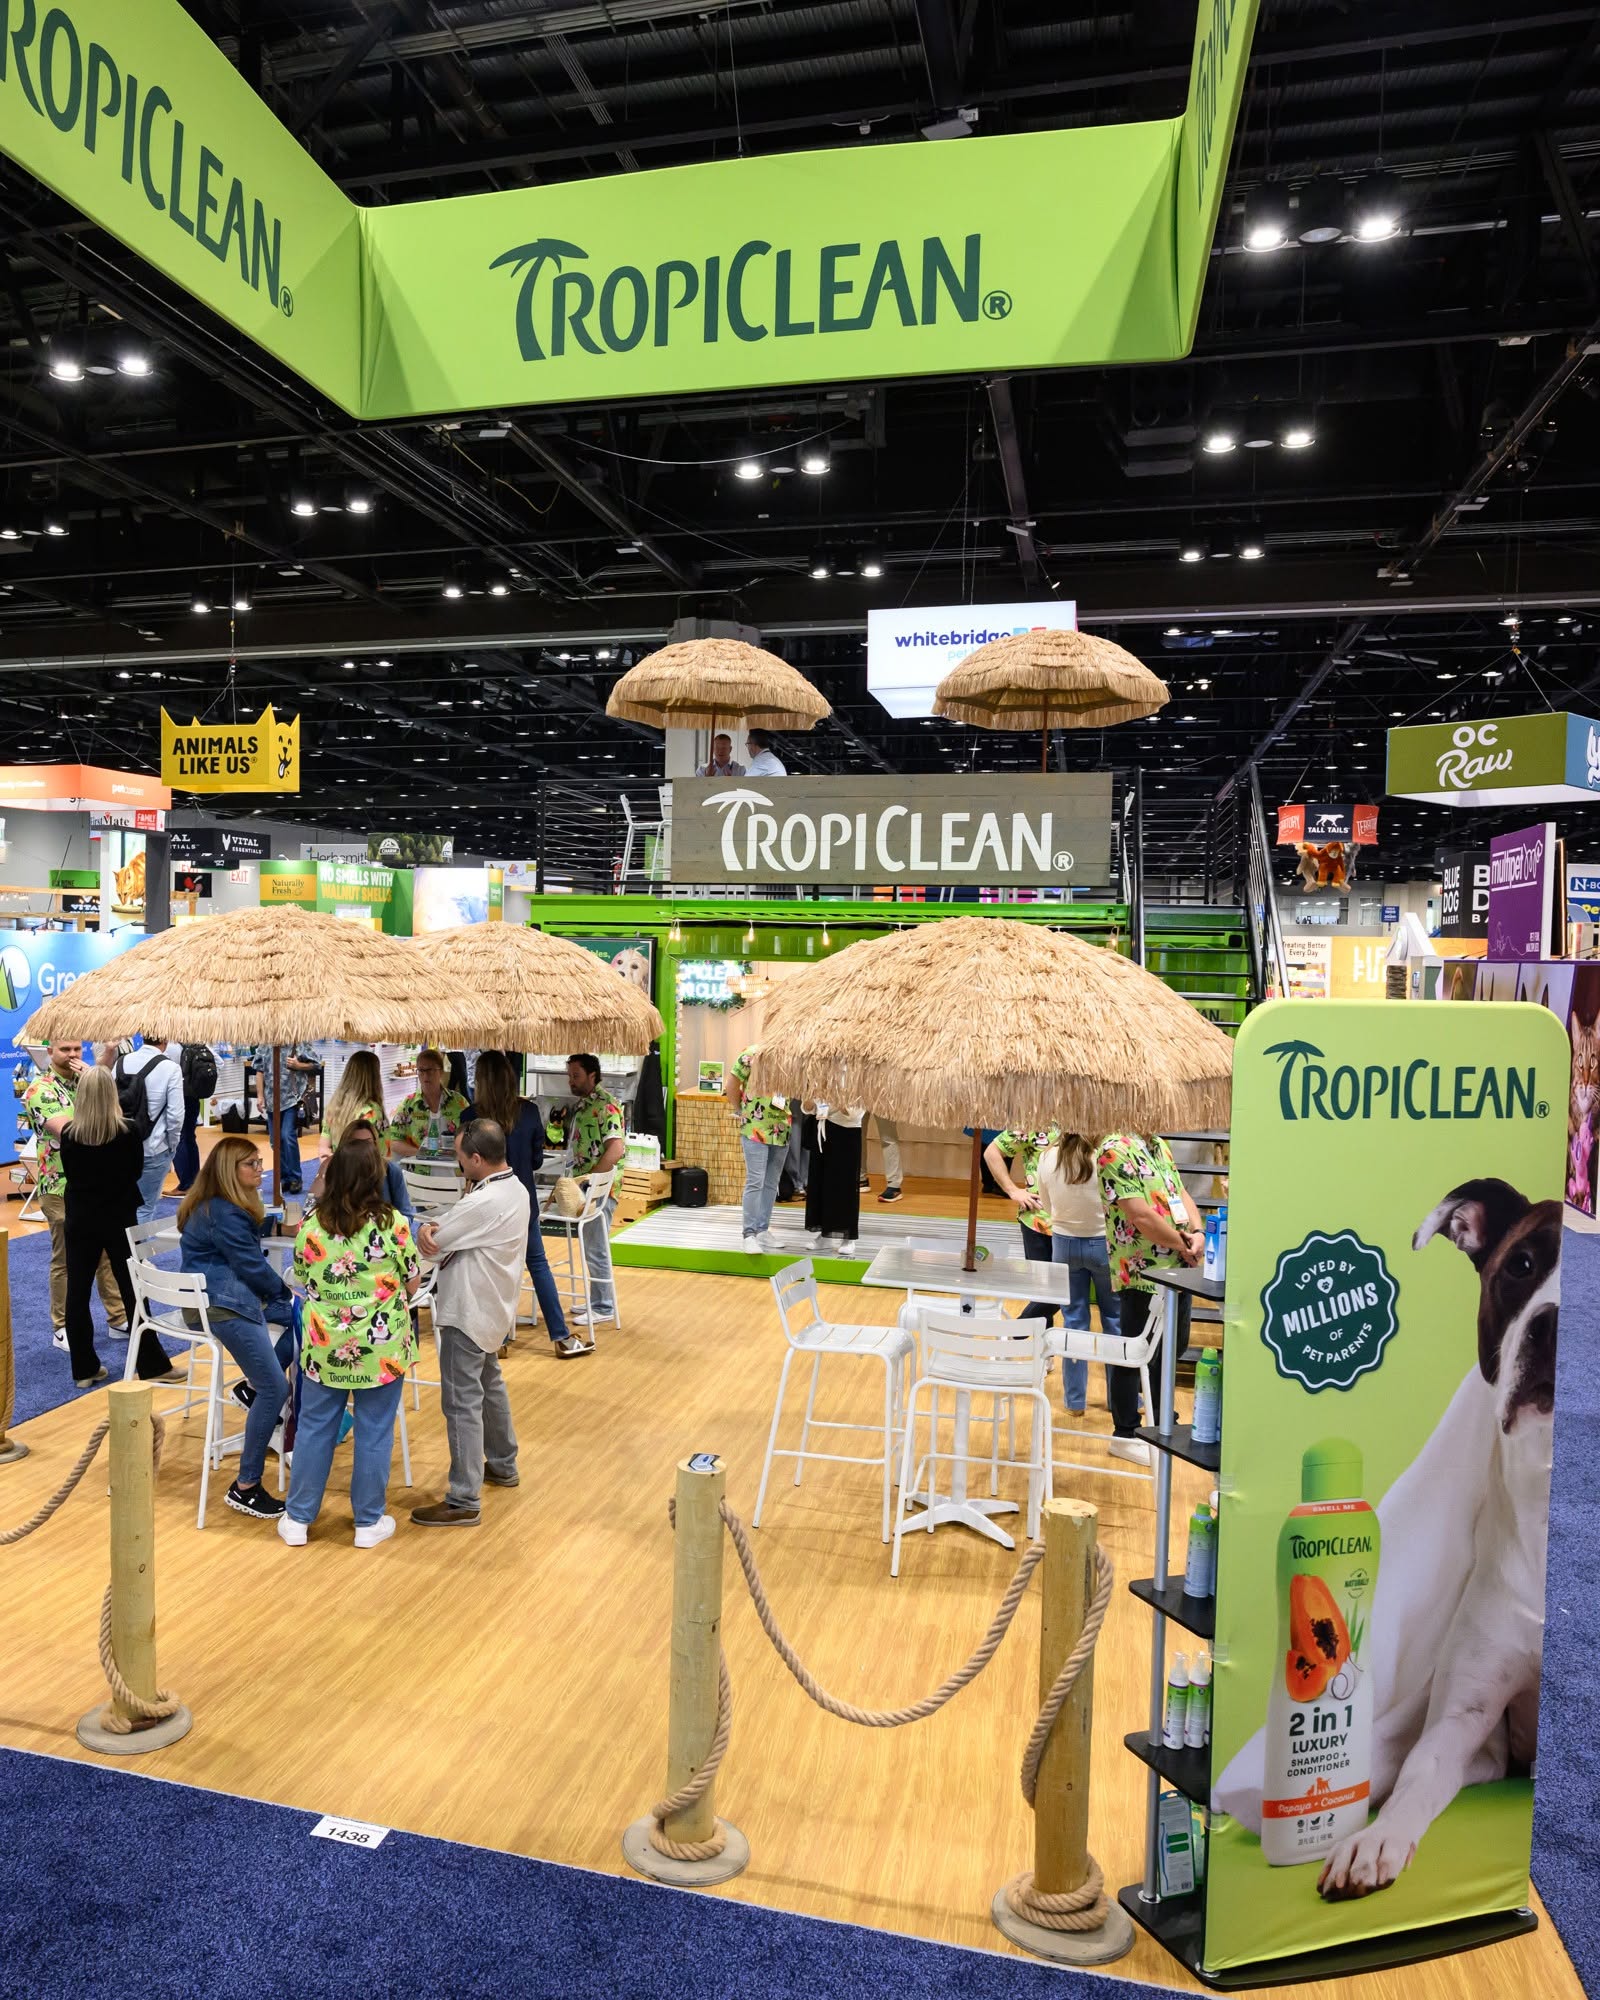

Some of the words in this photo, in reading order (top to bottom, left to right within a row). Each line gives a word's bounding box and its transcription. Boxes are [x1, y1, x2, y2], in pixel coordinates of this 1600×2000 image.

[172, 736, 258, 755] ANIMALS
[1453, 724, 1498, 748] OC
[179, 757, 220, 774] LIKE
[232, 836, 259, 847] VITAL
[231, 869, 248, 882] EXIT
[272, 879, 304, 888] Naturally
[320, 866, 335, 882] NO
[336, 868, 369, 886] SMELLS
[370, 871, 393, 887] WITH
[1444, 866, 1460, 890] BLUE
[272, 886, 292, 895] Fresh
[321, 884, 360, 900] WALNUT
[361, 887, 393, 902] SHELLS
[1443, 890, 1459, 914] DOG
[1308, 949, 1319, 957] Day
[1295, 1259, 1335, 1291] LOVED
[1338, 1261, 1356, 1275] BY
[1282, 1282, 1379, 1338] MILLIONS
[1302, 1344, 1324, 1363] PET
[1326, 1321, 1374, 1364] PARENTS
[1329, 1328, 1344, 1341] OF
[1289, 1712, 1305, 1736] 2
[1313, 1706, 1337, 1734] in
[1344, 1704, 1353, 1728] 1
[1292, 1732, 1348, 1754] LUXURY
[1287, 1759, 1350, 1778] CONDITIONER
[1291, 1752, 1340, 1767] SHAMPOO
[1278, 1802, 1312, 1816] Papaya
[1321, 1790, 1356, 1808] Coconut
[328, 1827, 370, 1843] 1438
